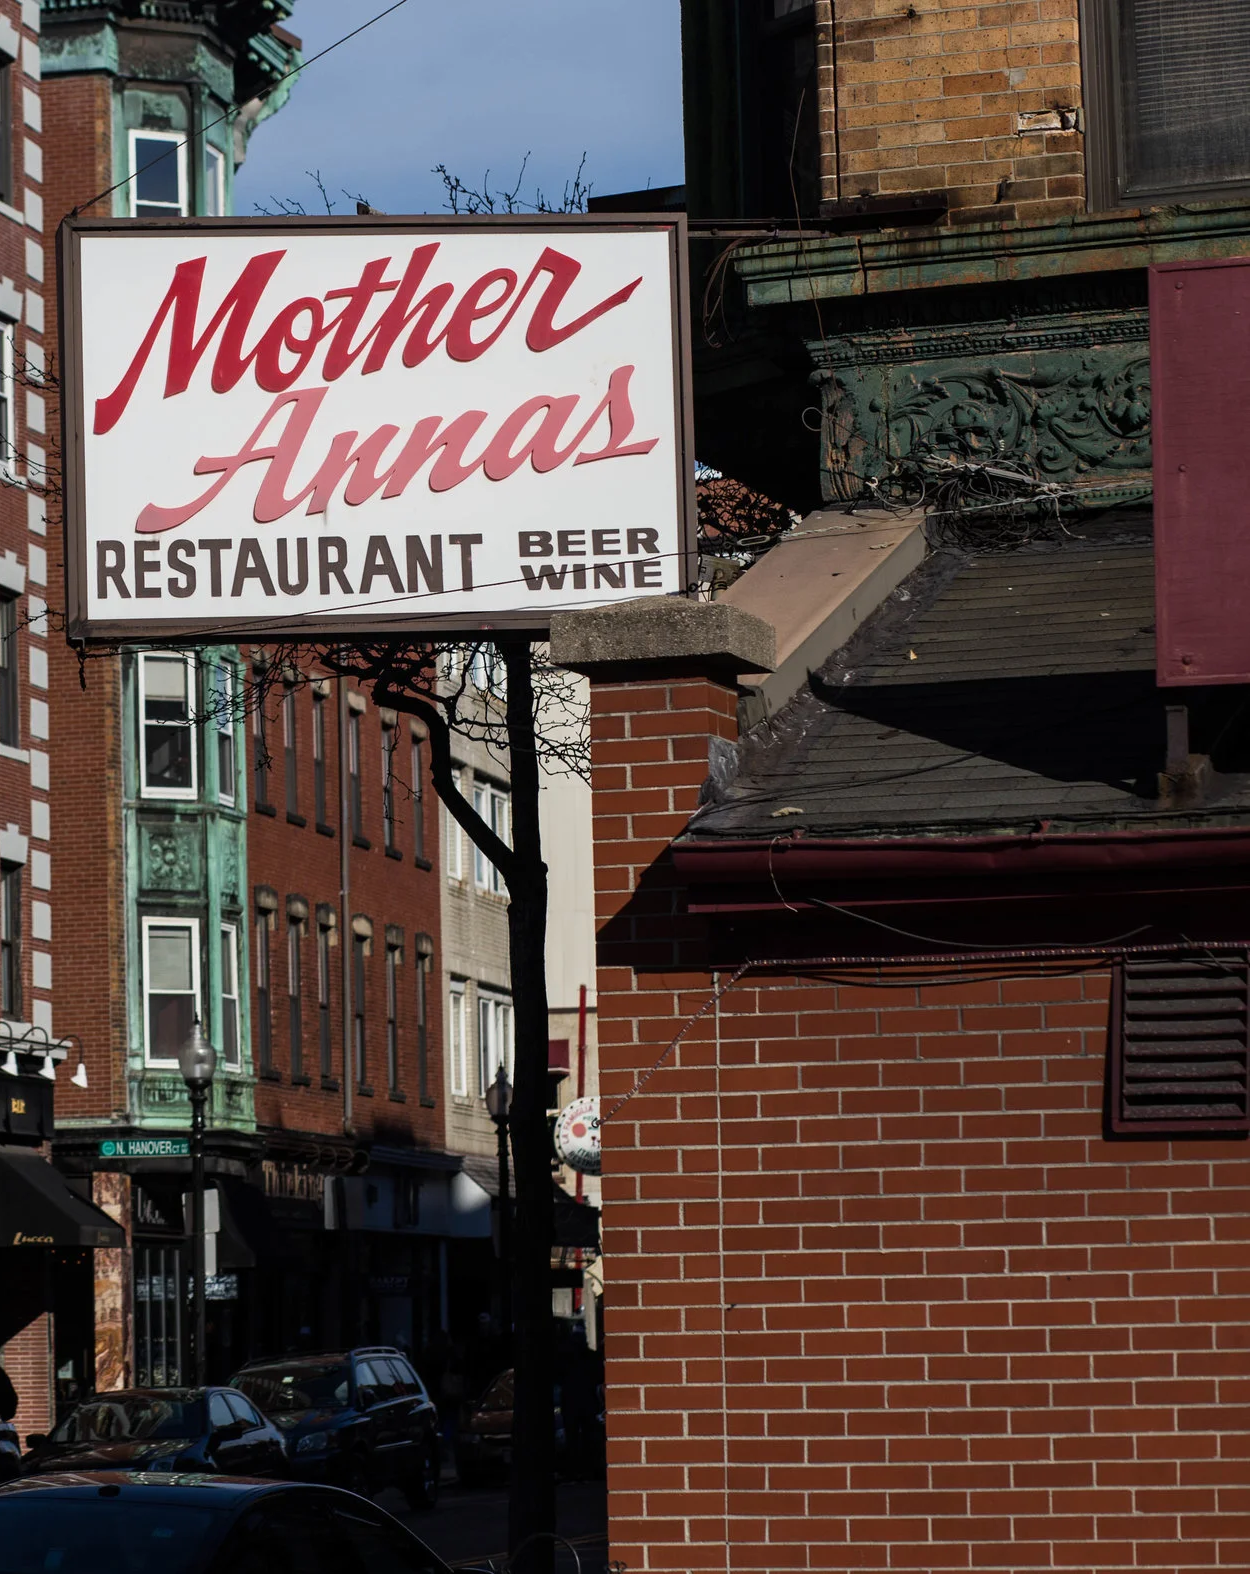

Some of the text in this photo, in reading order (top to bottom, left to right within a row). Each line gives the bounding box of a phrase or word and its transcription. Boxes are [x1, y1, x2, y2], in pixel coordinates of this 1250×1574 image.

[93, 241, 643, 436] Mother
[135, 364, 660, 535] Annas
[96, 532, 484, 599] RESTAURANT
[518, 526, 661, 558] BEER
[520, 560, 664, 592] WINE
[128, 1141, 173, 1155] HANOVER
